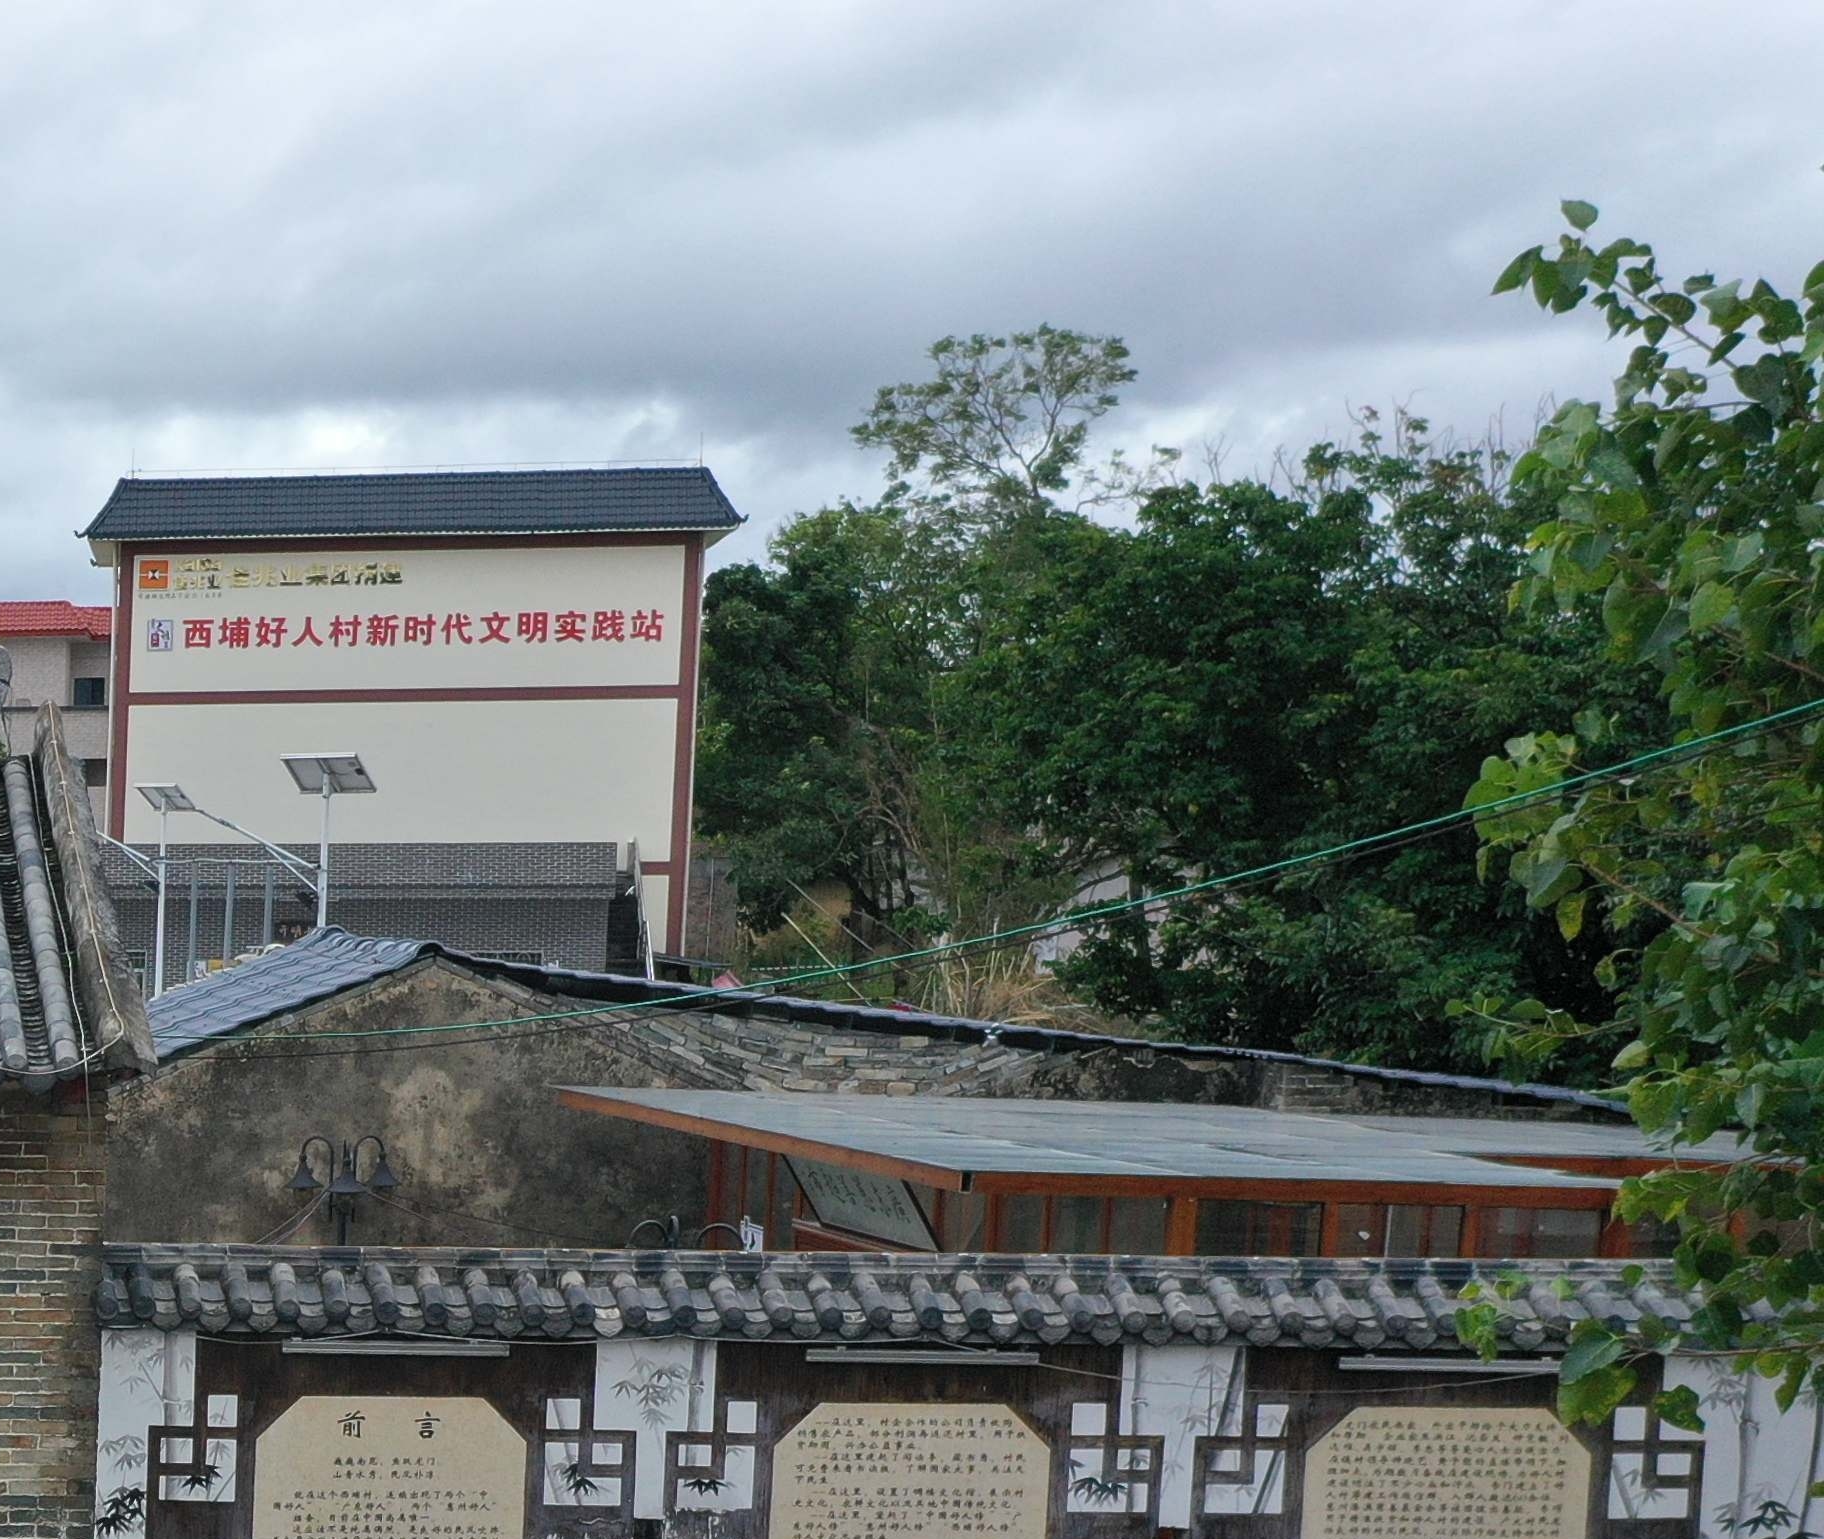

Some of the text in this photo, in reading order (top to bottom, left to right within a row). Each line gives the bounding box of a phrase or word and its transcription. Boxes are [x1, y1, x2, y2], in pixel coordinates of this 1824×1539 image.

[182, 608, 665, 650] 西埔好人村新时代文明实践站
